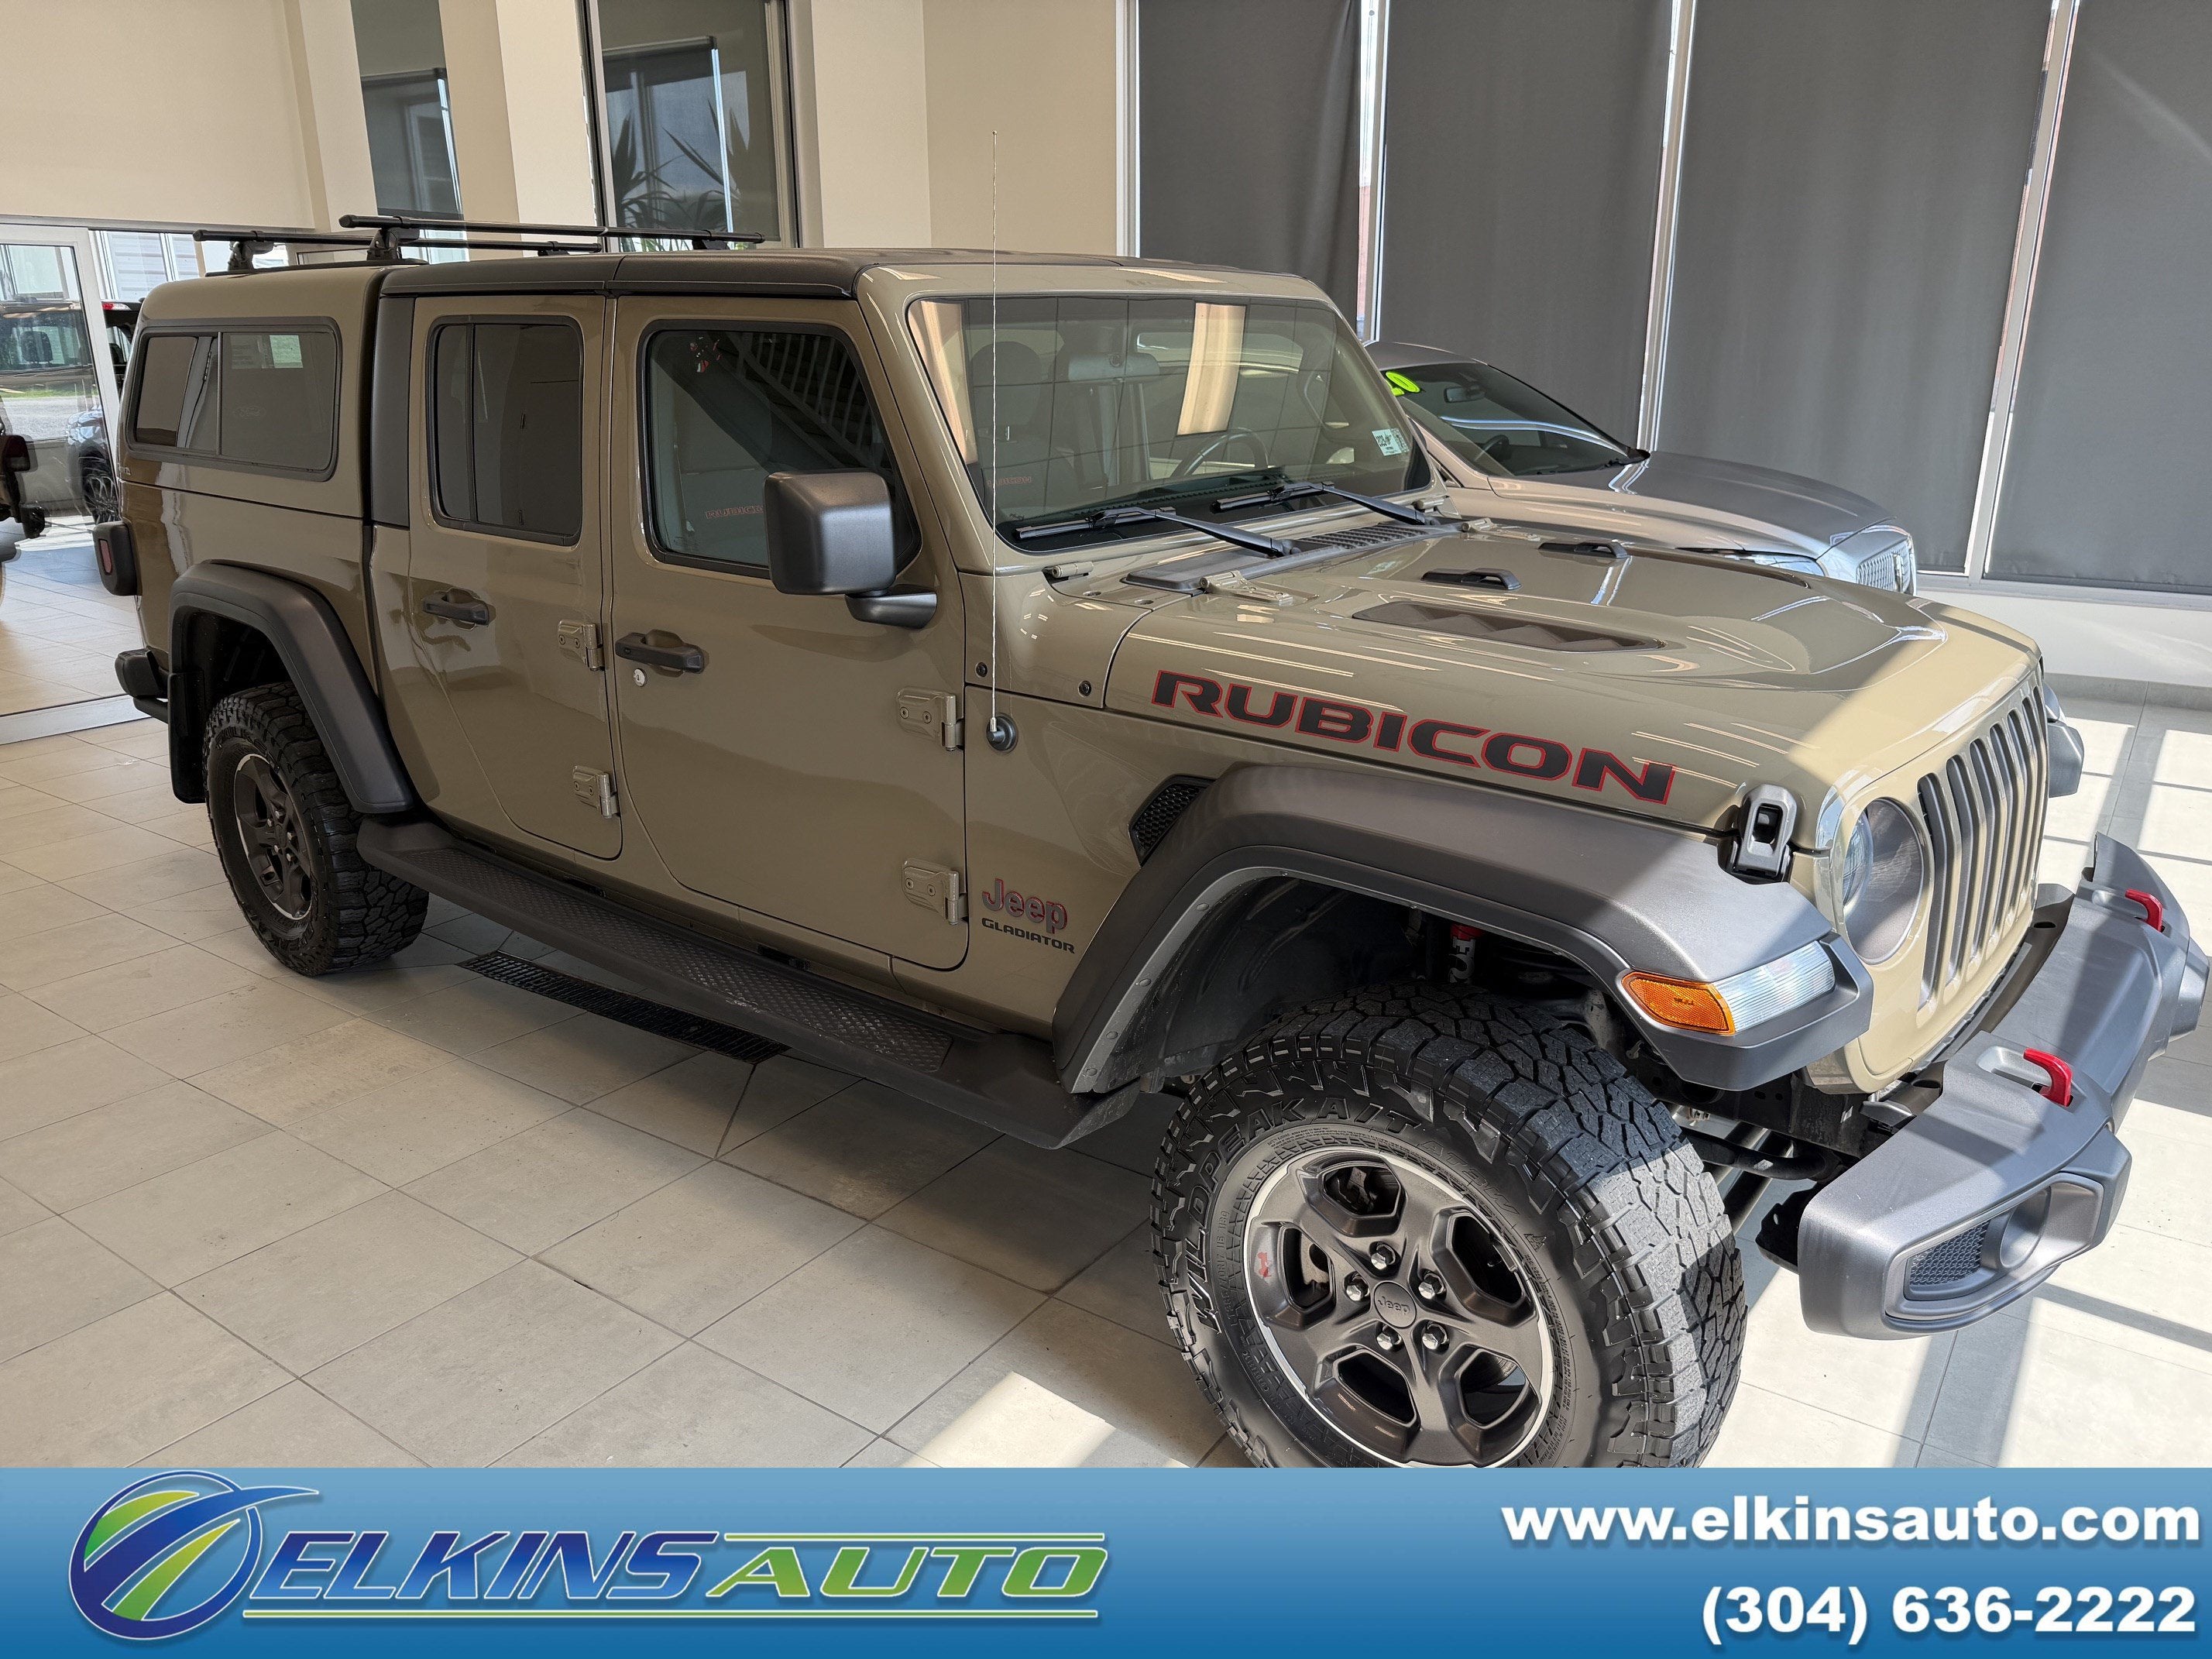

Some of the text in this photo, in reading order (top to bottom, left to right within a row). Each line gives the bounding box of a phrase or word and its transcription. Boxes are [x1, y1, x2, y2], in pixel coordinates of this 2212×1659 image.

[705, 505, 764, 520] RUBICO
[1151, 670, 1677, 805] RUBICON
[981, 878, 1068, 935] Jeep
[981, 917, 1075, 954] GLADIATOR
[1184, 1097, 1307, 1334] WILDPEAK
[1317, 1097, 1423, 1134] A/T
[1378, 1296, 1410, 1315] Jeep
